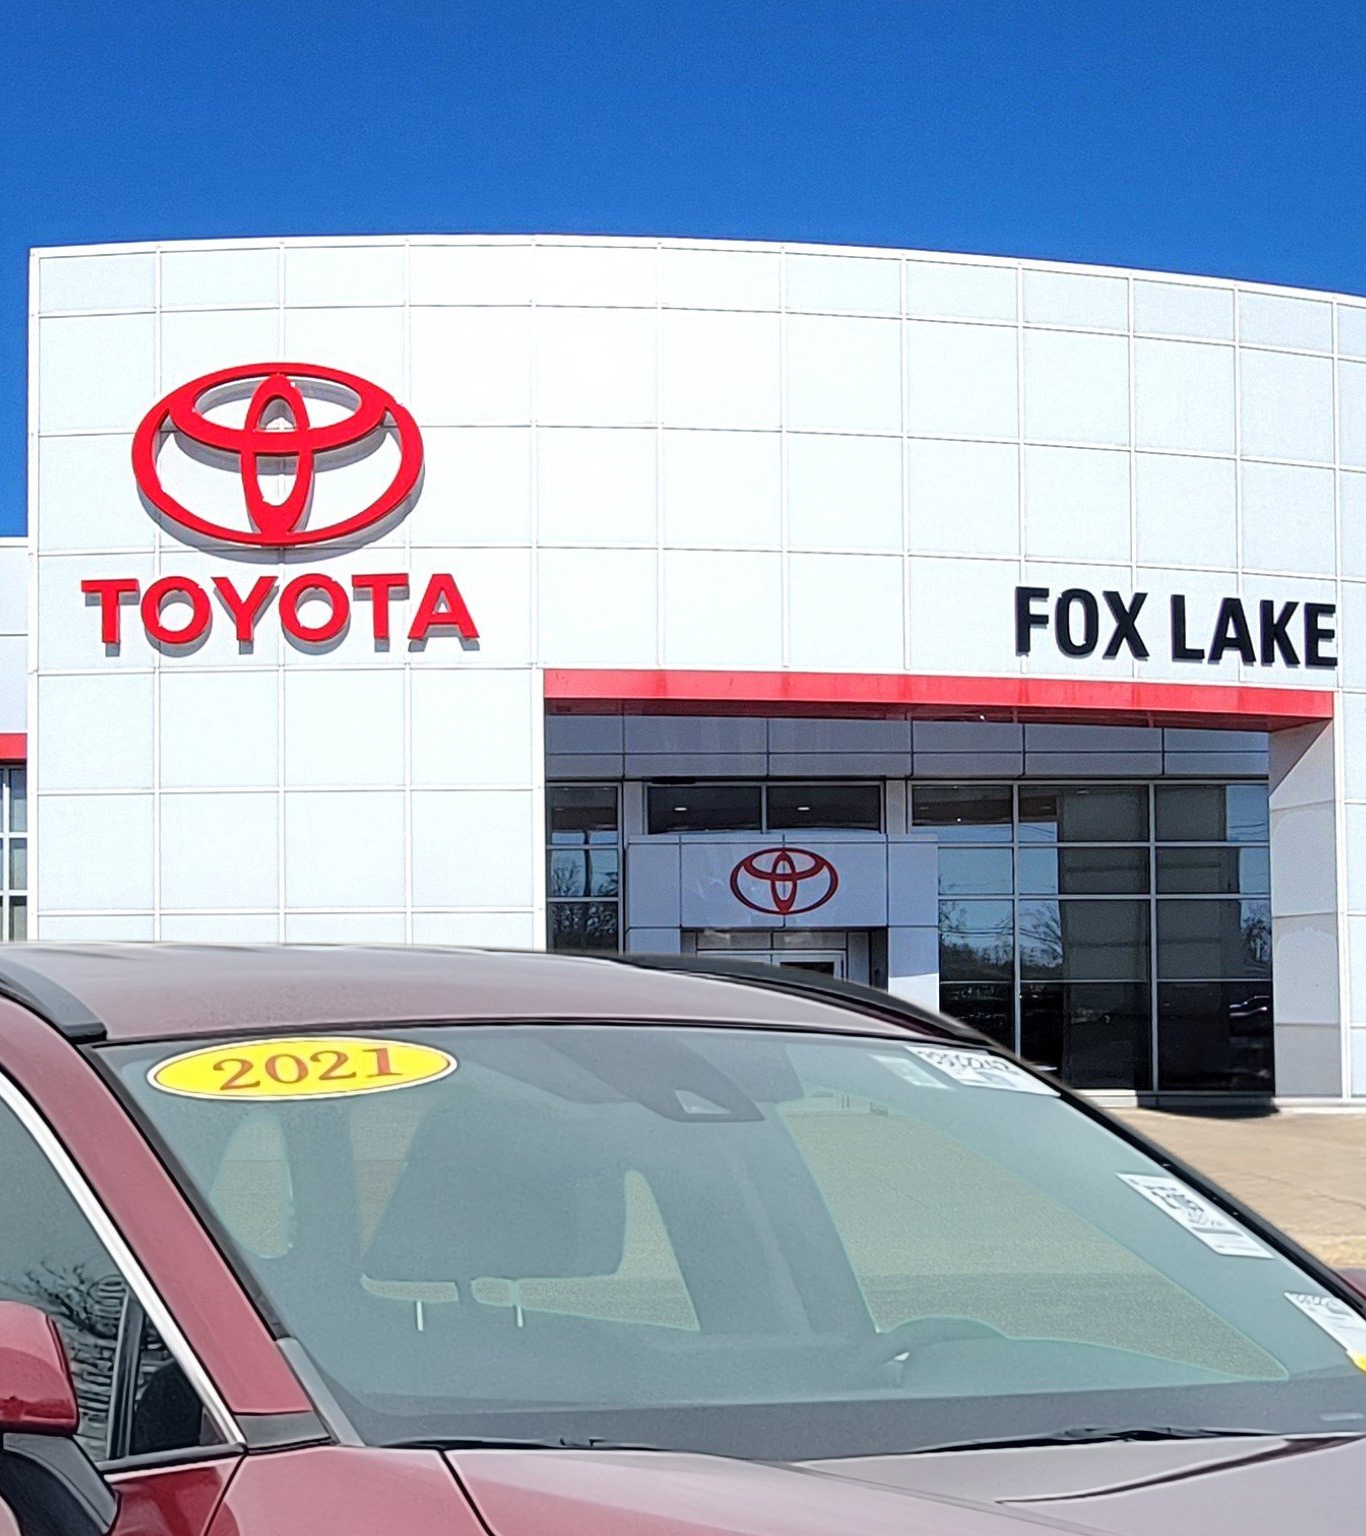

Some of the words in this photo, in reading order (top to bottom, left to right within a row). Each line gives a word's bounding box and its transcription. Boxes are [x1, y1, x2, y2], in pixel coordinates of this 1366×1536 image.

[81, 573, 481, 648] TOYOTA
[1015, 586, 1150, 658] FOX
[1170, 594, 1338, 667] LAKE
[212, 1047, 403, 1091] 2021
